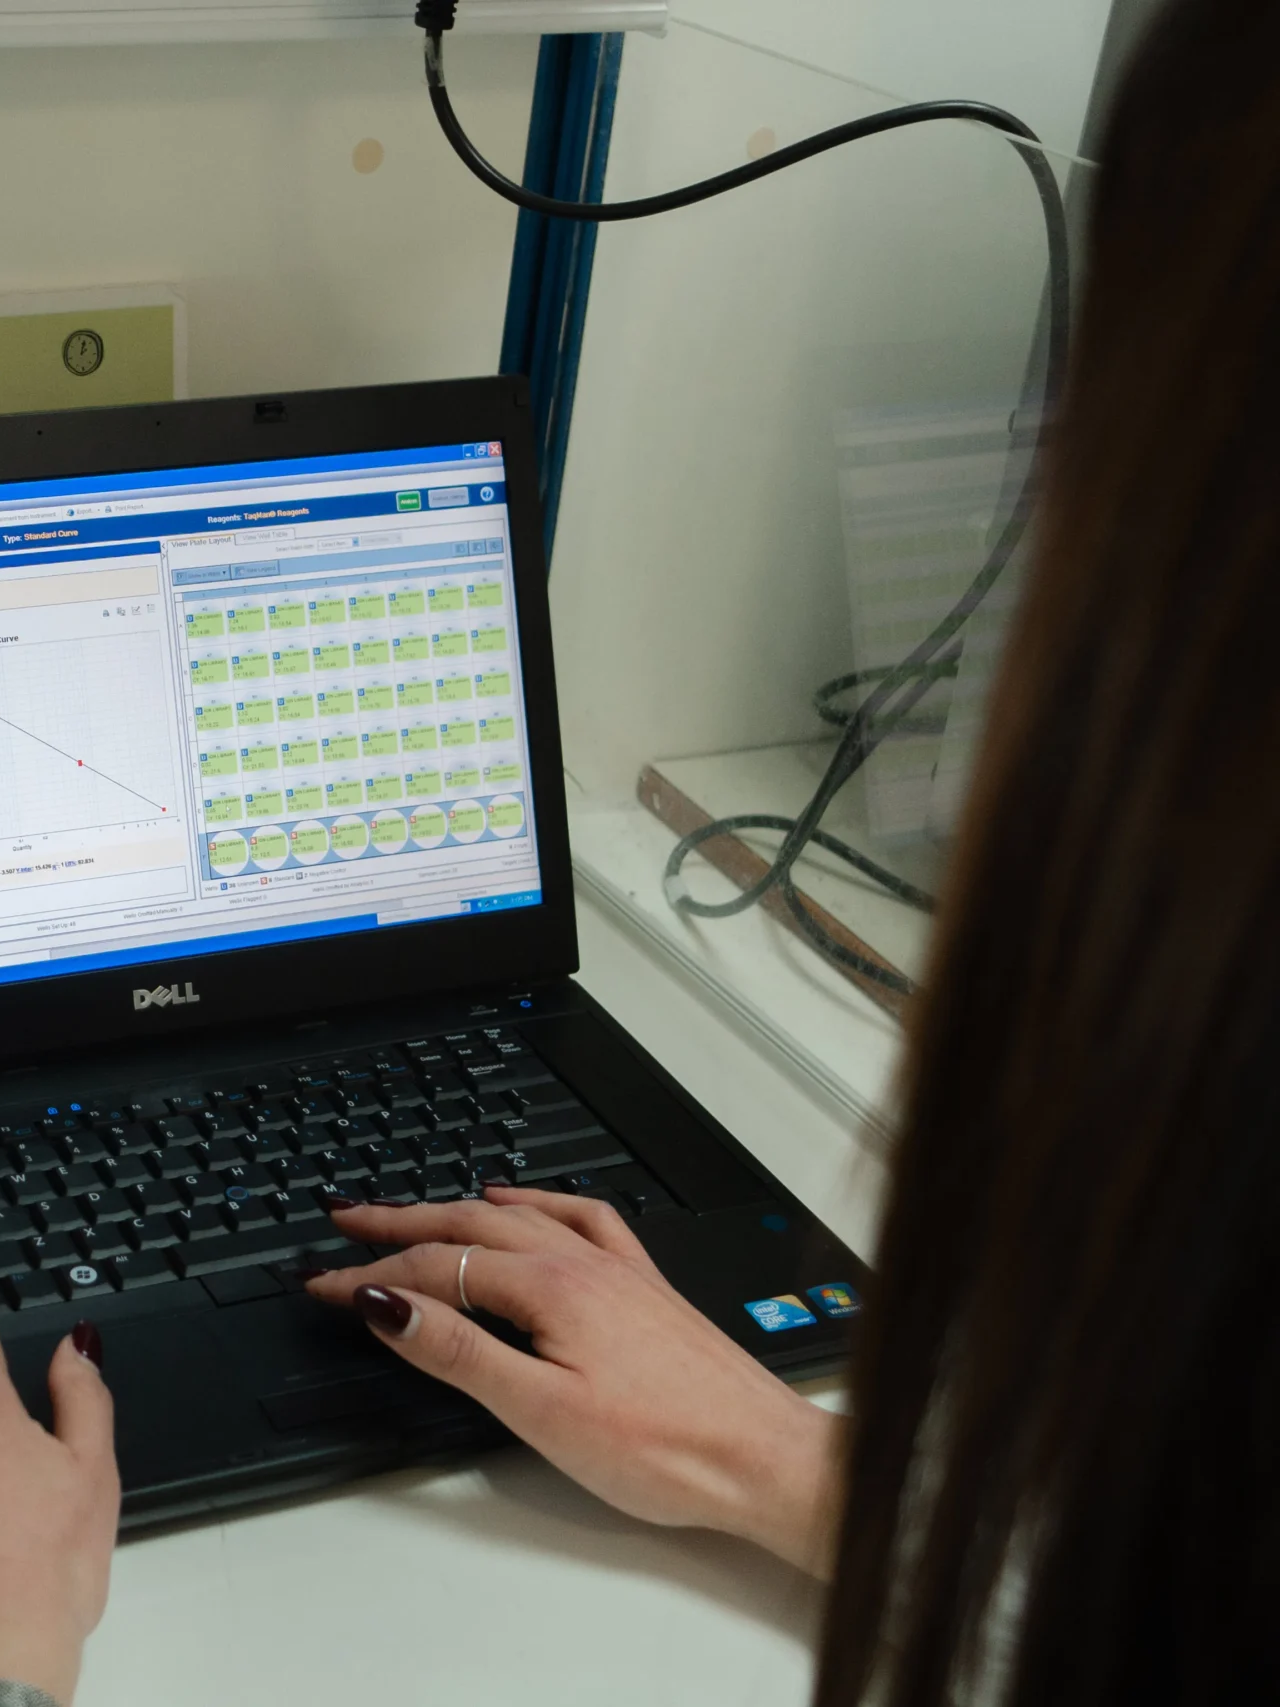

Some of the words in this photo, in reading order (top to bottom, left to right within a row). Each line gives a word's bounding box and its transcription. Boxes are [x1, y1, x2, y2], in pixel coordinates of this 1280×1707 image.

[208, 514, 242, 524] Reagents:
[277, 508, 309, 517] Reagents
[3, 535, 22, 544] Type:
[24, 531, 57, 541] Standard
[58, 529, 79, 537] Curve
[171, 540, 188, 549] View
[189, 538, 207, 547] Plate
[208, 536, 231, 546] Layout
[133, 982, 200, 1010] DELL
[445, 1033, 467, 1041] Home
[467, 1063, 505, 1073] Backspace
[380, 1110, 390, 1119] P
[338, 1119, 349, 1127] O
[502, 1118, 523, 1126] Enter
[246, 1134, 257, 1142] U
[200, 1142, 210, 1150] Y
[369, 1144, 380, 1152] L
[153, 1150, 163, 1158] T
[324, 1151, 336, 1160] K
[505, 1152, 525, 1160] Shift
[106, 1158, 118, 1167] R
[280, 1159, 288, 1167] J
[58, 1167, 68, 1175] E
[232, 1167, 244, 1176] H
[11, 1174, 26, 1183] W
[185, 1176, 197, 1184] G
[137, 1184, 145, 1193] F
[323, 1184, 338, 1193] M
[88, 1192, 100, 1201] D
[276, 1192, 290, 1201] N
[41, 1202, 50, 1210] S
[228, 1201, 240, 1210] B
[180, 1209, 192, 1218] V
[133, 1219, 145, 1228] C
[84, 1227, 96, 1237] X
[34, 1236, 45, 1246] Z
